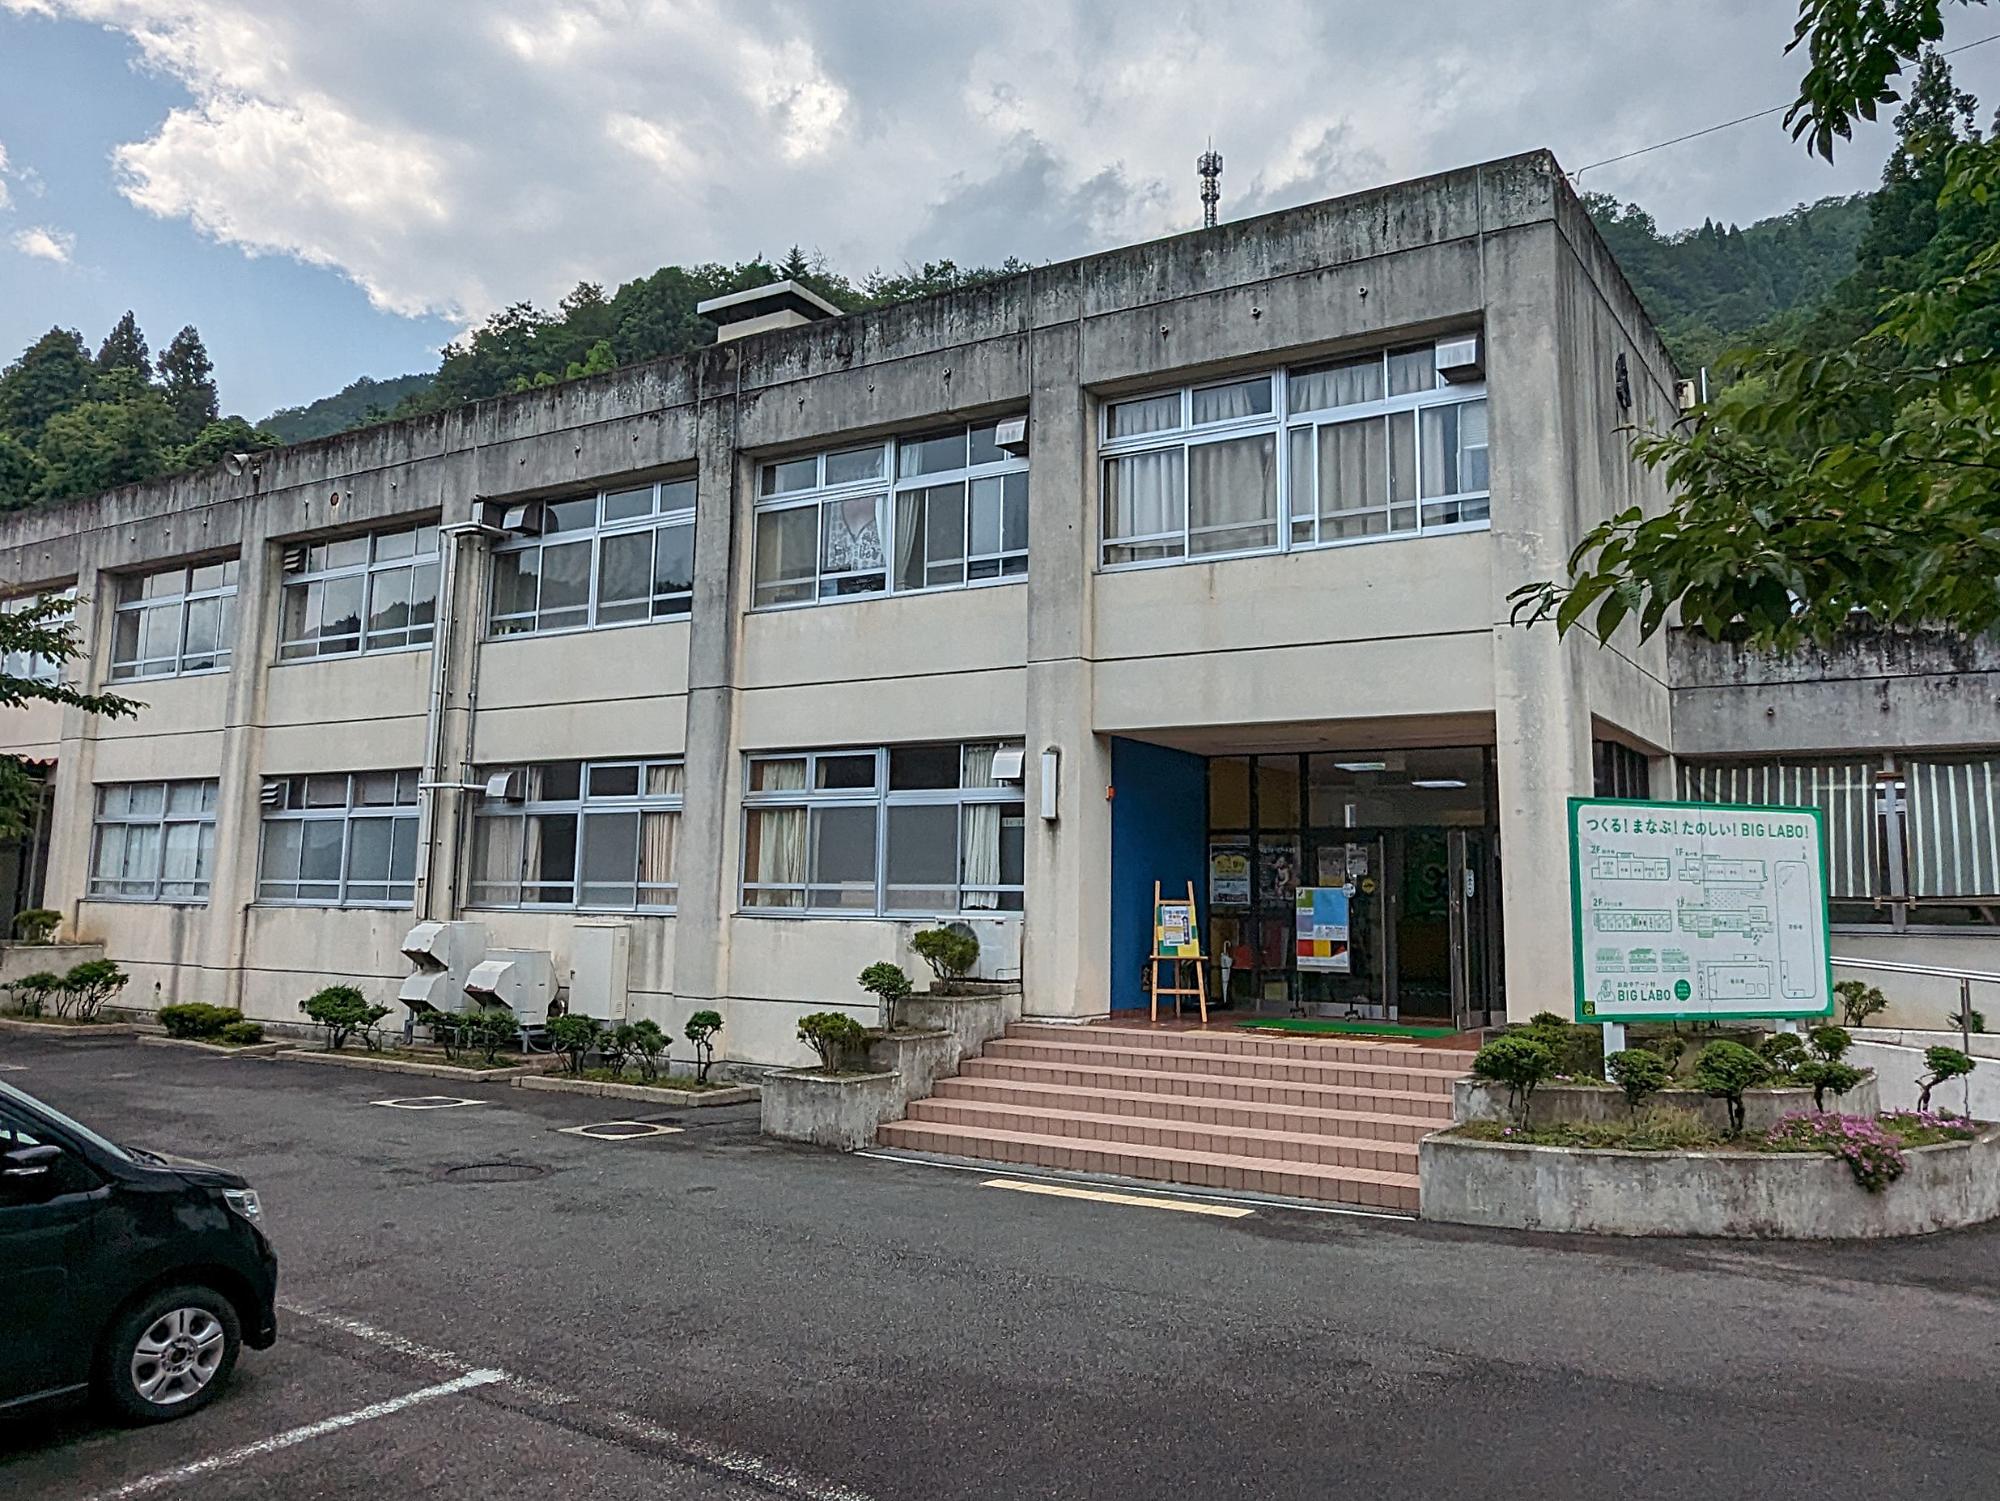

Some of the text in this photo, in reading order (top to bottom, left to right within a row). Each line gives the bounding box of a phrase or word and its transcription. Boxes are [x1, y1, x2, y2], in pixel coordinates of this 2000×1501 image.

[1741, 823, 1765, 837] BIG
[1768, 824, 1809, 839] LABO!
[1593, 898, 1603, 907] 2F
[1618, 990, 1638, 1001] BIG
[1641, 989, 1671, 1001] LABO
